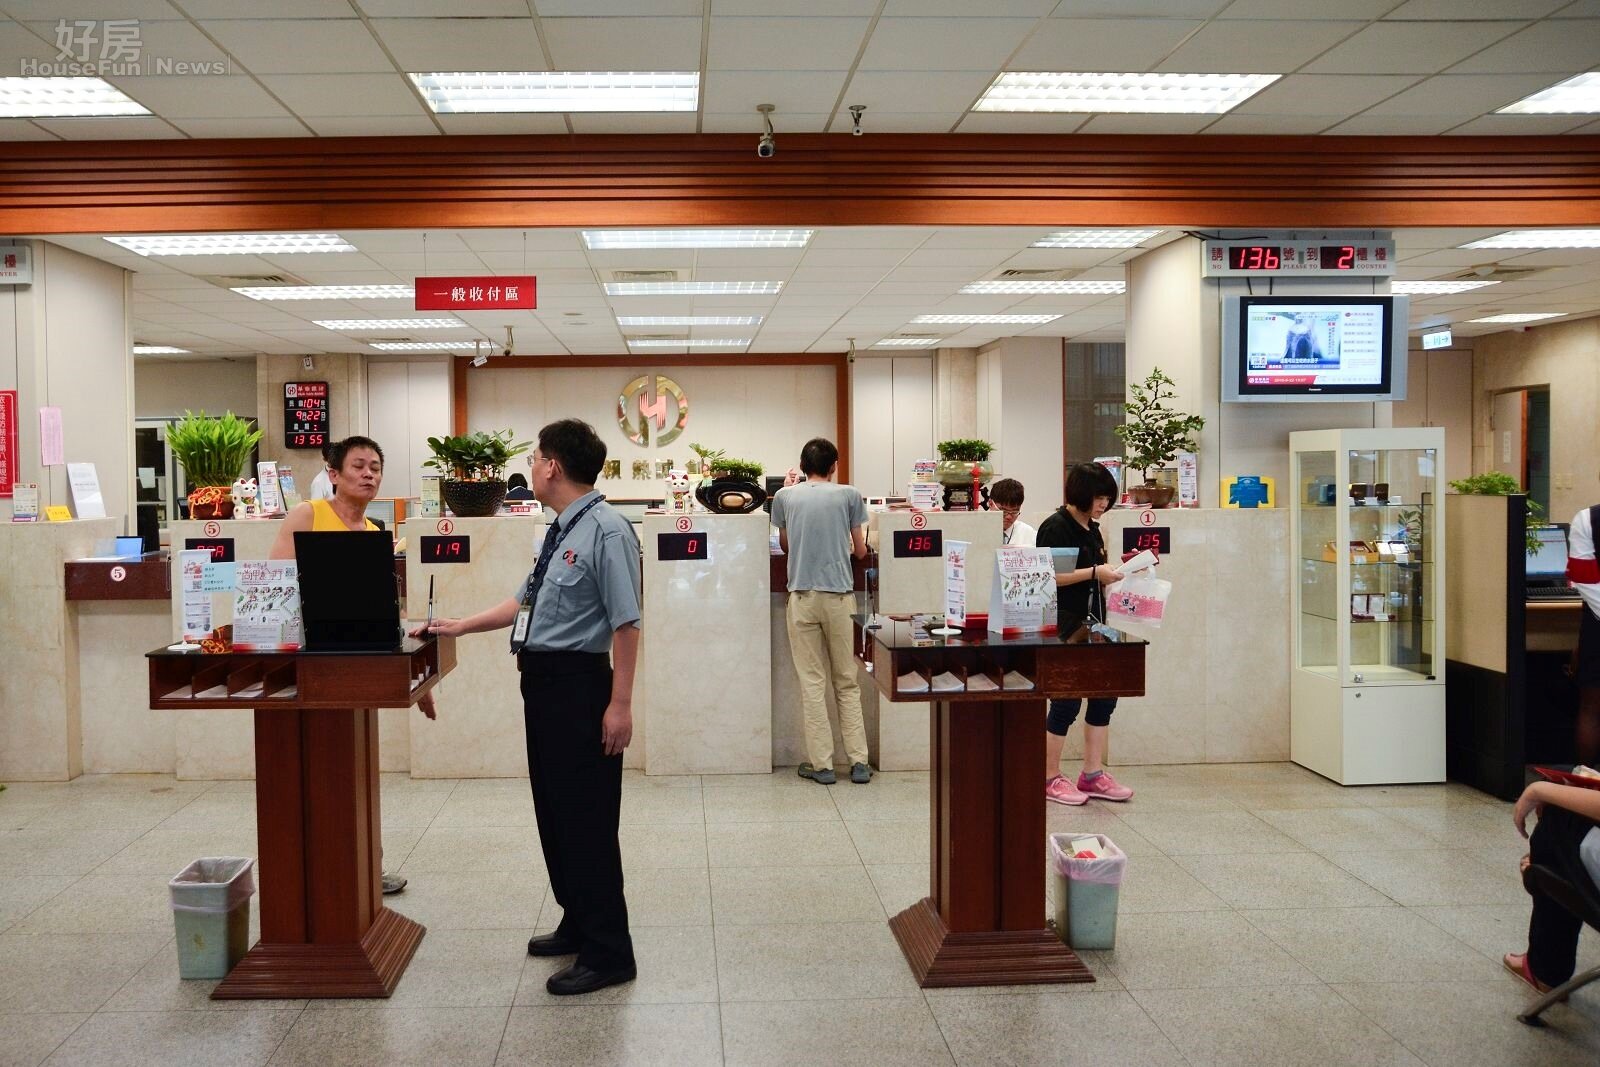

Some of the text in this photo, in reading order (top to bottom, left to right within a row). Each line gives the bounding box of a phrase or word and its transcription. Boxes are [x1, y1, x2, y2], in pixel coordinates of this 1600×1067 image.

[1238, 247, 1279, 270] 136
[1337, 247, 1354, 270] 2
[433, 285, 520, 303] 一般收付區
[303, 399, 320, 408] 104
[296, 411, 303, 420] 9
[307, 411, 321, 420] 22
[687, 540, 697, 554] 0
[908, 537, 931, 550] 136
[1137, 534, 1161, 548] 135
[435, 542, 460, 556] 119
